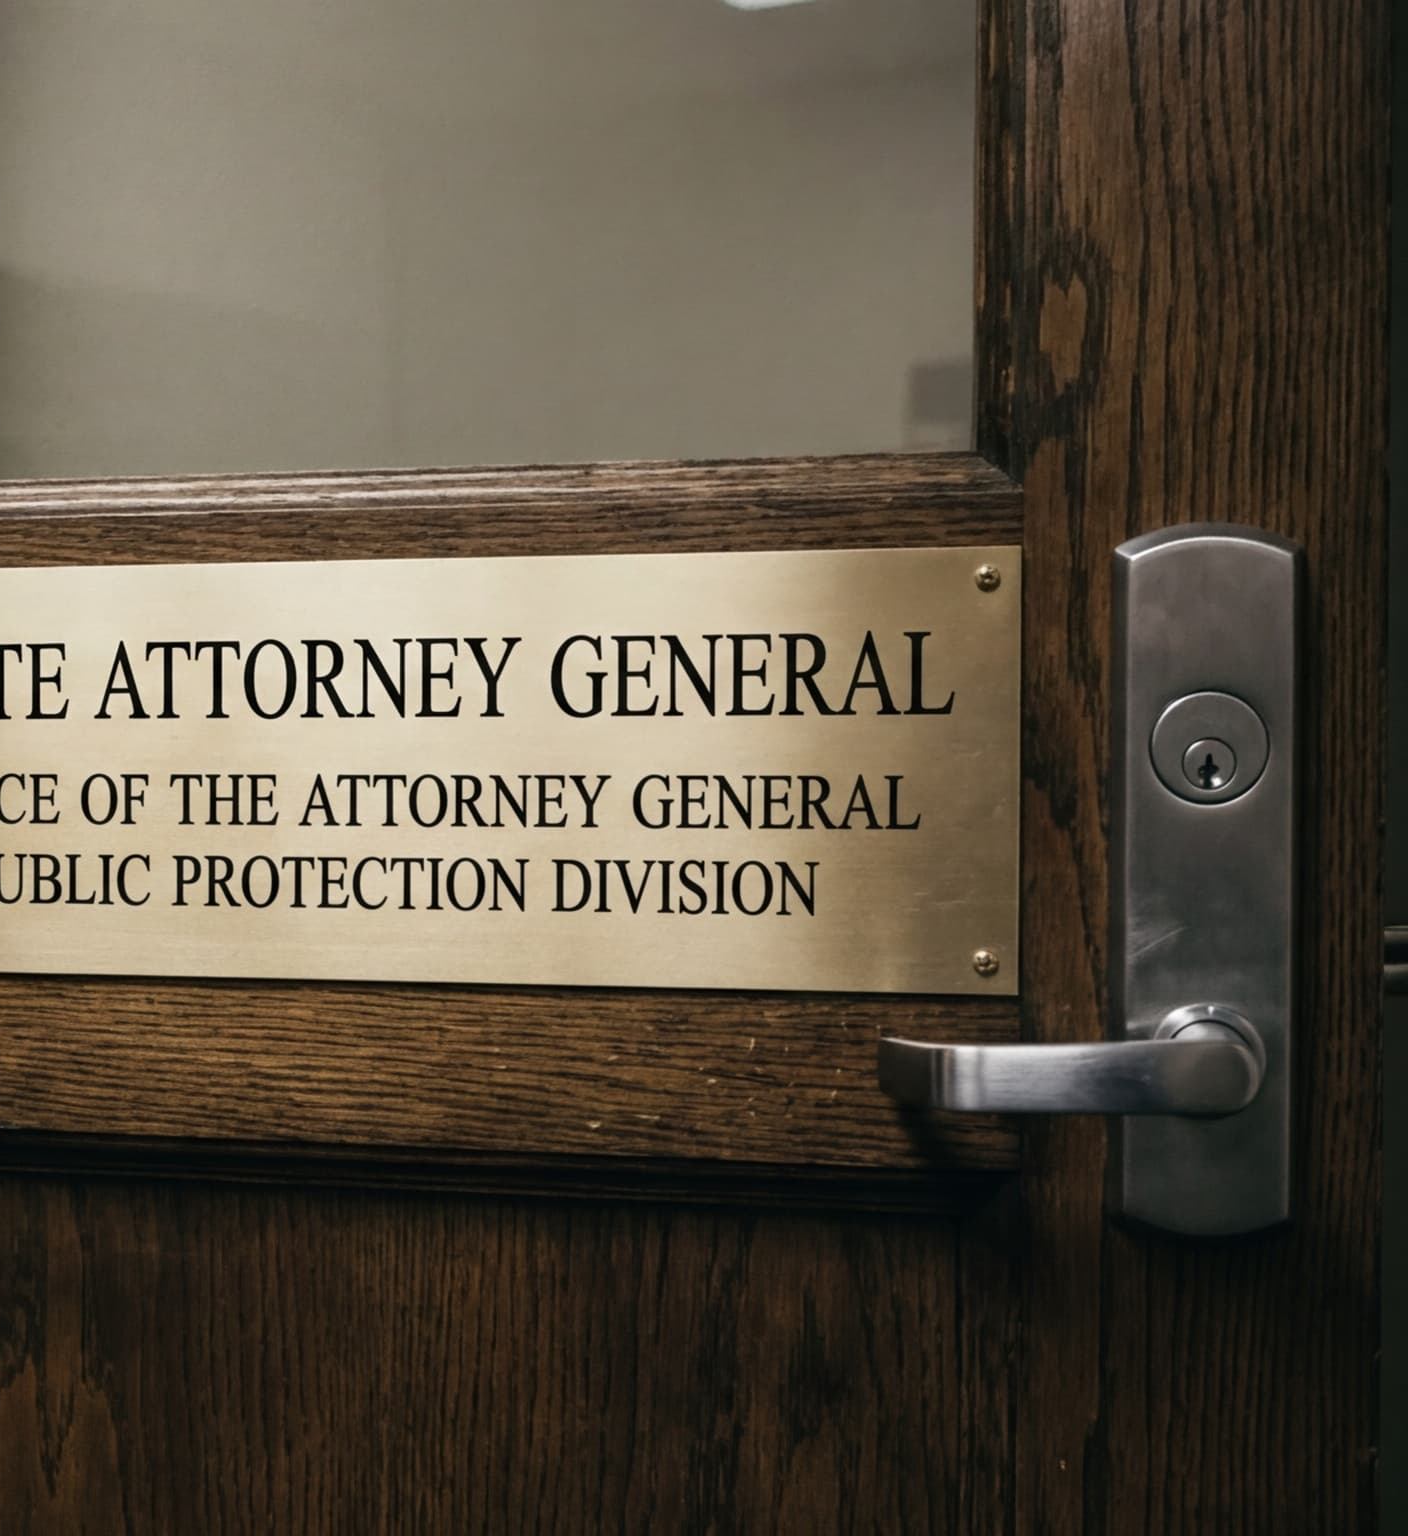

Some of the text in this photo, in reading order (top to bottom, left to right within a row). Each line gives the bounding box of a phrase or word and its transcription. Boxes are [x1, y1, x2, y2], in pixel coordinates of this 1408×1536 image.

[94, 637, 522, 720] ATTORNEY
[550, 630, 956, 719] GENERAL
[80, 773, 149, 826] OF
[169, 774, 279, 826] THE
[298, 773, 612, 828] ATTORNEY
[632, 773, 923, 831] GENERAL
[171, 855, 530, 912] PROTECTION
[551, 859, 820, 917] DIVISION
